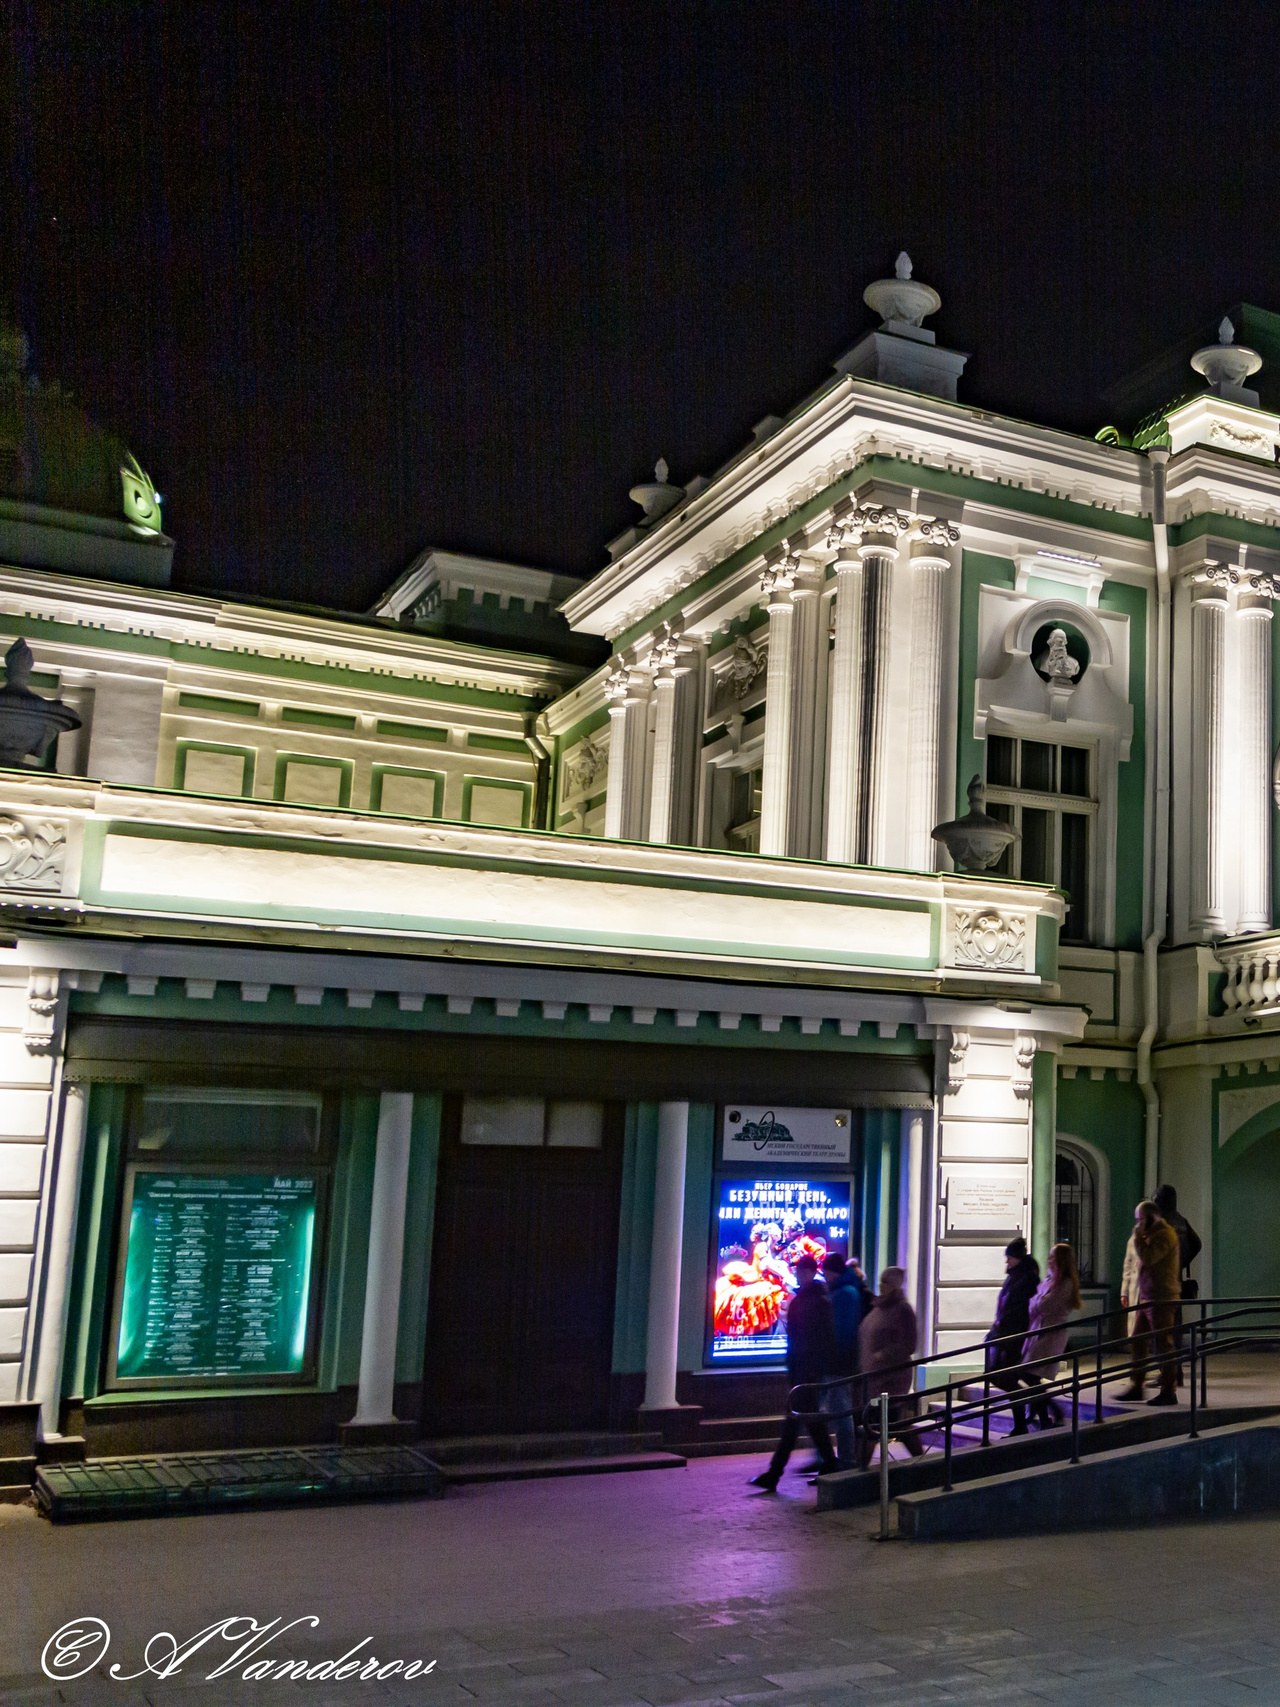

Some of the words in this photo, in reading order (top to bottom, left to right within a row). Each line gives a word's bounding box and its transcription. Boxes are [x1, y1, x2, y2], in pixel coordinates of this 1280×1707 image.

[729, 1190, 793, 1202] БЕЗУМНЫЙ
[744, 1207, 802, 1220] ЖЕНИТЬБА
[805, 1208, 848, 1220] ФИГАРО
